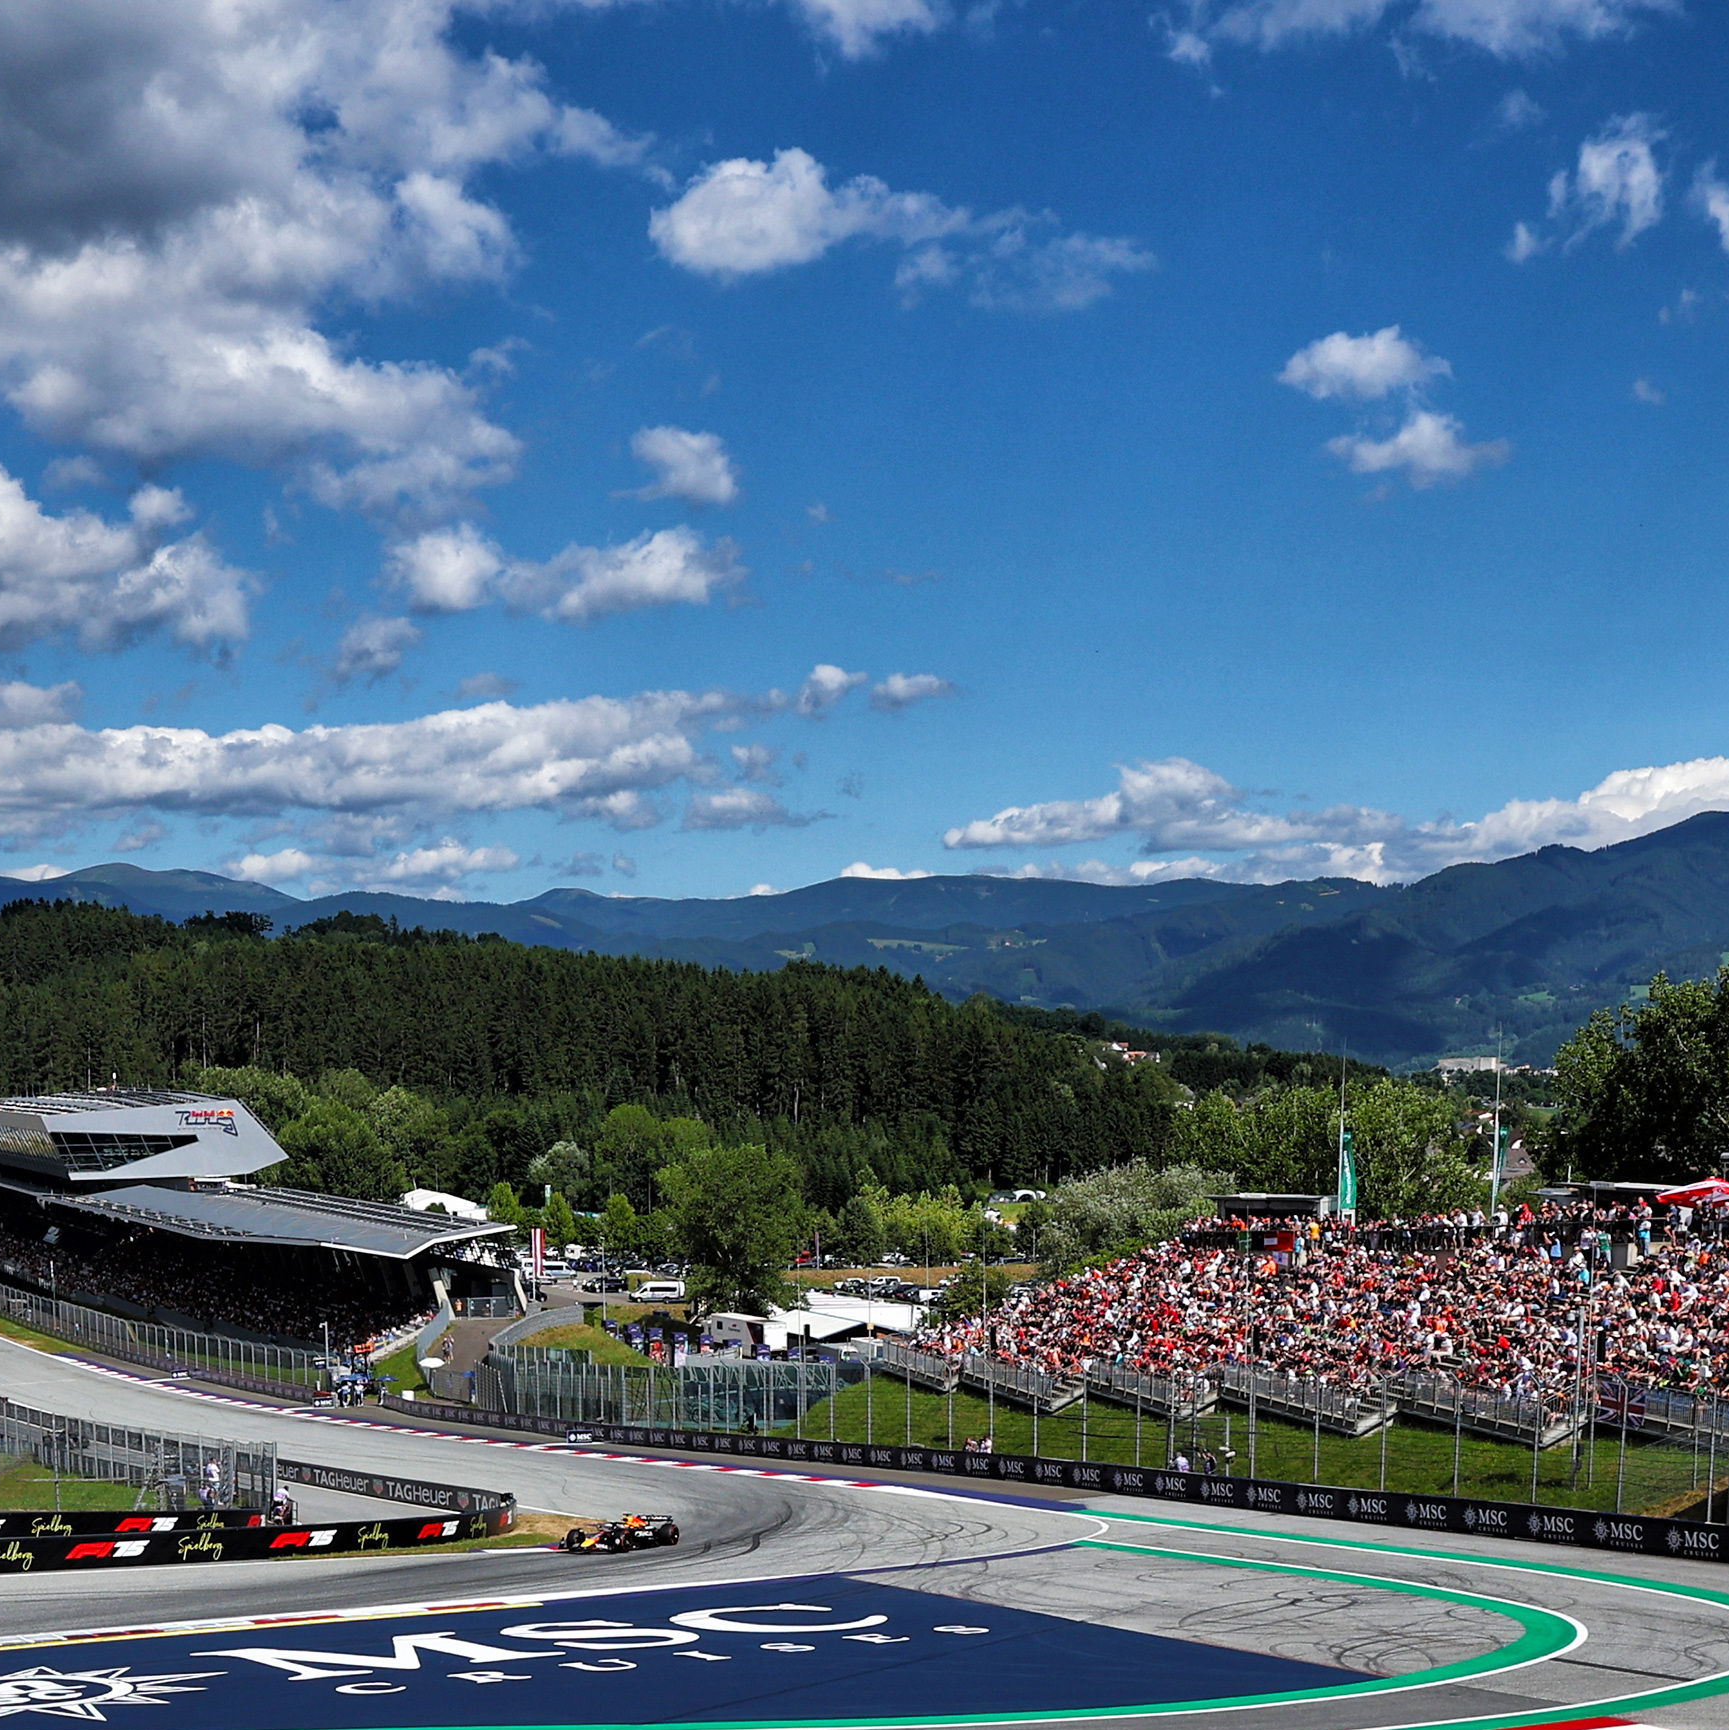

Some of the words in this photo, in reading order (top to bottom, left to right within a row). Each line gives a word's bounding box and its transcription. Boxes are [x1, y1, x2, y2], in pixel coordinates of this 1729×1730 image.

[576, 1433, 593, 1441] MSC
[767, 1440, 781, 1453] MSC
[793, 1443, 806, 1455] MSC
[819, 1446, 833, 1457] MSC
[847, 1448, 862, 1460] MSC
[876, 1450, 891, 1463] MSC
[907, 1452, 922, 1465] MSC
[938, 1454, 955, 1467] MSC
[972, 1457, 989, 1470] MSC
[1006, 1460, 1024, 1474] MSC
[1044, 1464, 1062, 1478] MSC
[1082, 1468, 1100, 1482] MSC
[1123, 1472, 1144, 1487] MSC
[1164, 1476, 1186, 1492] MSC
[1210, 1481, 1234, 1497] MSC
[1257, 1487, 1281, 1503] MSC
[1308, 1492, 1333, 1509] MSC
[1360, 1498, 1387, 1515] MSC
[1419, 1503, 1447, 1520] MSC
[1478, 1508, 1507, 1526] MSC
[1543, 1515, 1575, 1534] MSC
[31, 1514, 73, 1538] Spielberg
[1610, 1522, 1643, 1541] MSC
[357, 1522, 389, 1549] Spielberg
[1683, 1531, 1719, 1550] MSC
[177, 1528, 224, 1561] Spielberg
[1610, 1541, 1643, 1549] CRUISES
[1683, 1549, 1719, 1558] CRUISES
[190, 1603, 888, 1681] MSC
[335, 1624, 990, 1695] CRUISES
